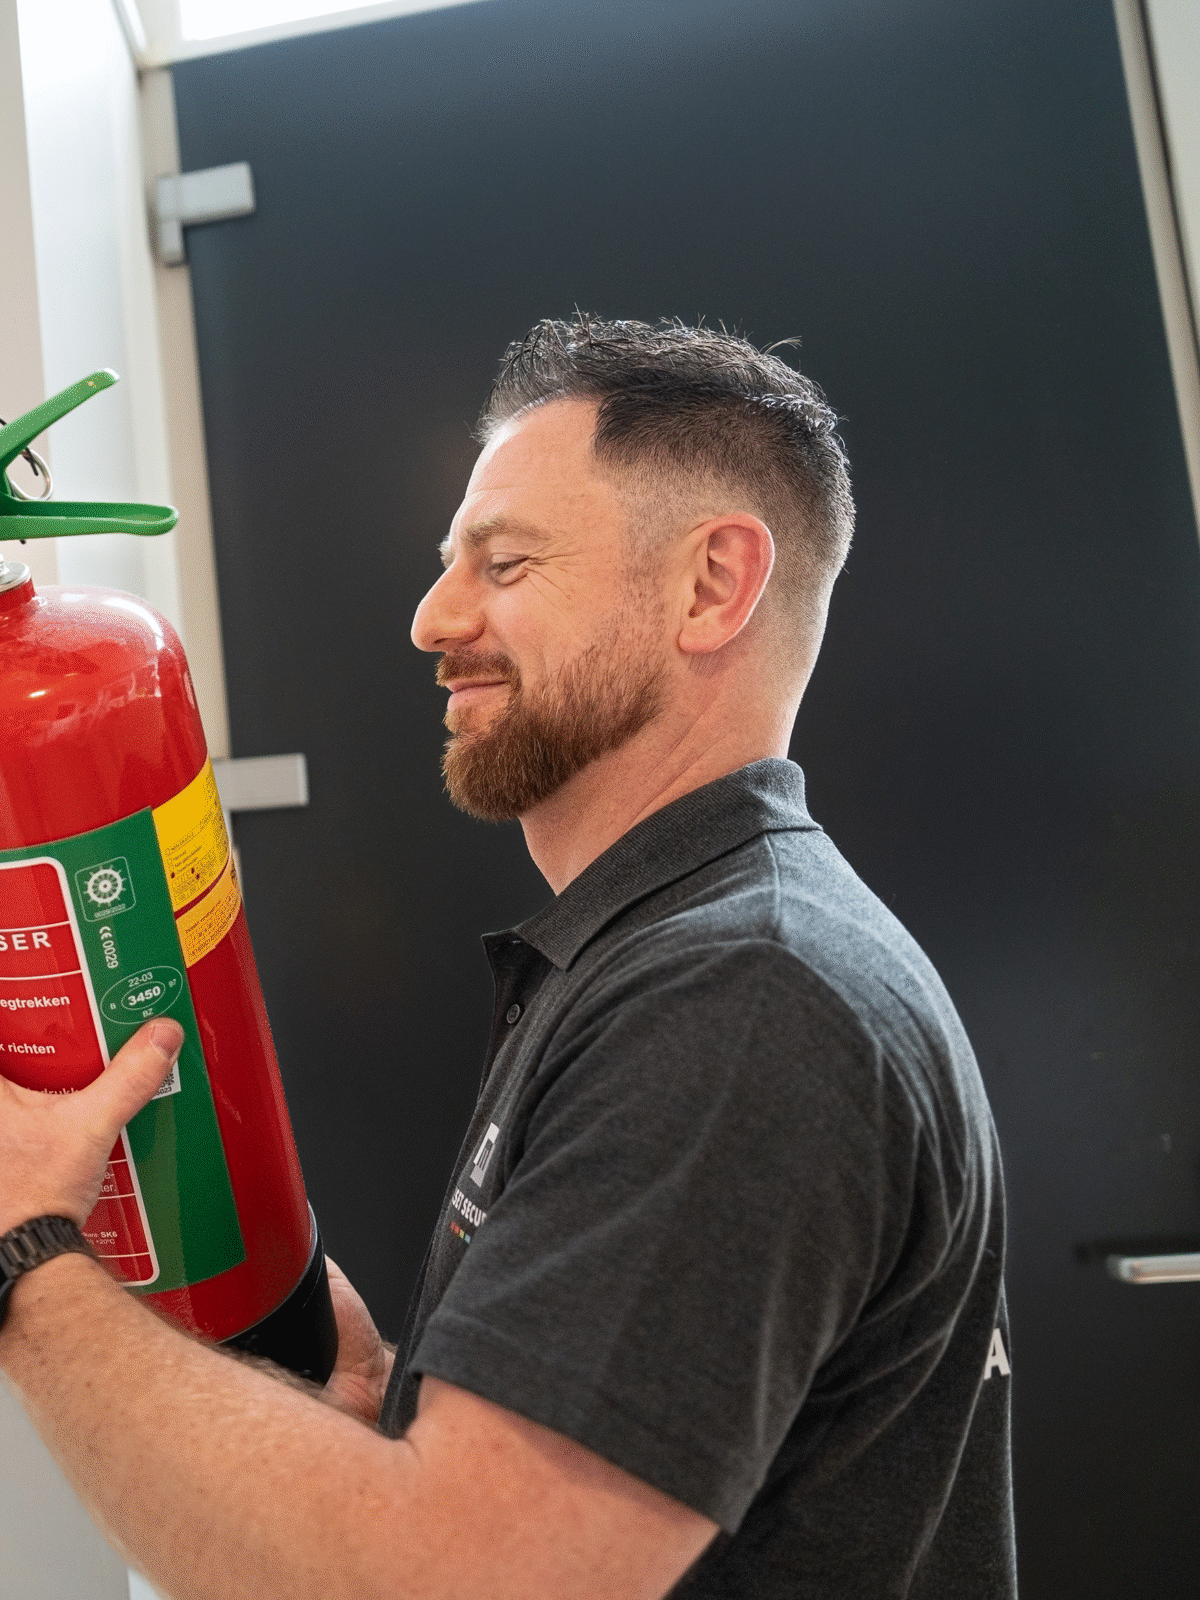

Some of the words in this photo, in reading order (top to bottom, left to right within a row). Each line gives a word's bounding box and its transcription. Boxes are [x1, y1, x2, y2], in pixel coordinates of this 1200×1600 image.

[101, 940, 119, 970] 0029
[127, 971, 154, 989] 22-03
[127, 985, 162, 1006] 3450
[8, 1043, 56, 1055] richten
[983, 1327, 1011, 1380] A
